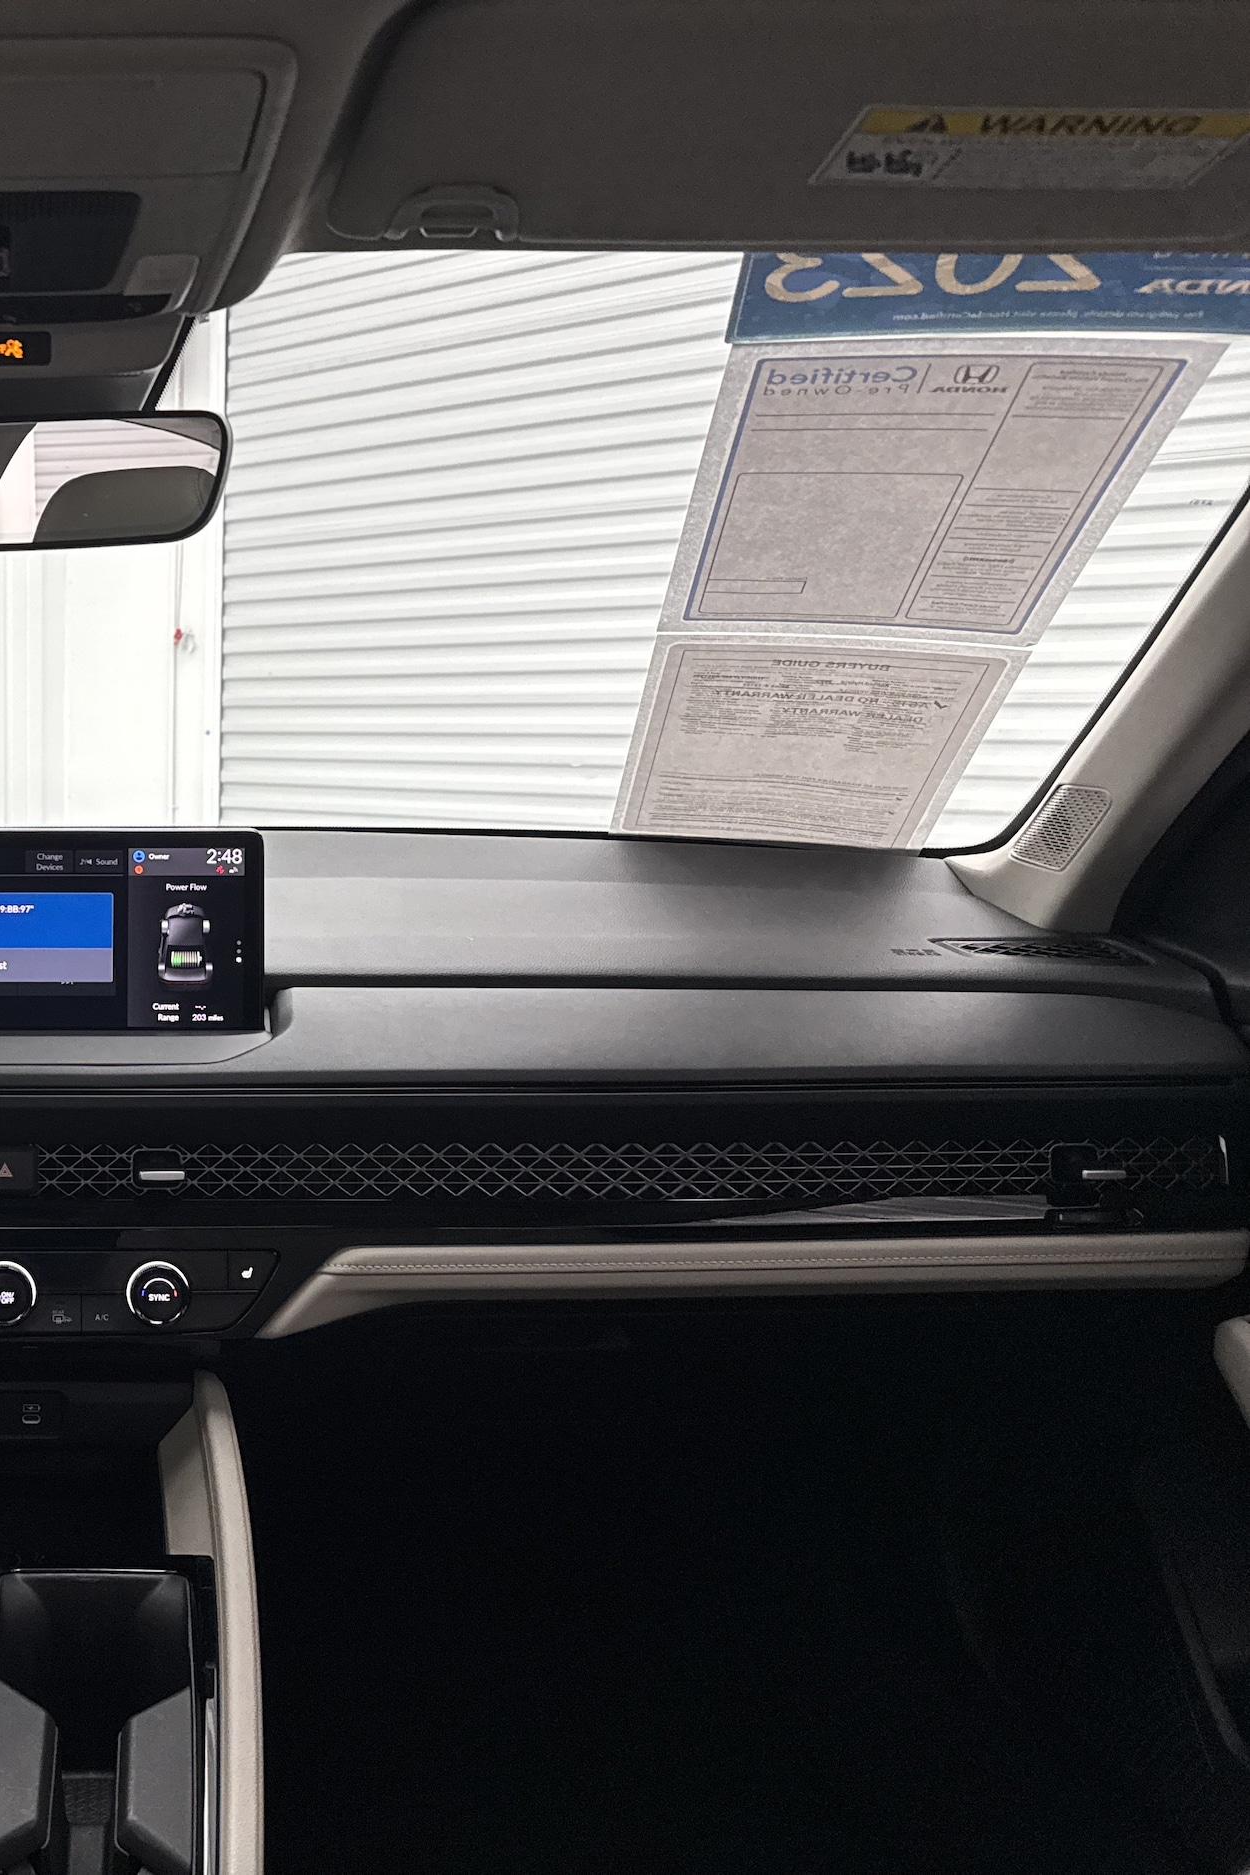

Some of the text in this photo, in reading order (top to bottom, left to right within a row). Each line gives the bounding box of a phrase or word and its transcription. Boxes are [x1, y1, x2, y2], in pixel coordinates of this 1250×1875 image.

[979, 113, 1203, 135] WARNING
[36, 853, 64, 862] Change
[206, 848, 243, 865] 2:48
[95, 858, 118, 866] Sound
[36, 863, 64, 871] Devices
[165, 883, 207, 892] Power Flow
[157, 1013, 179, 1022] Range
[148, 1293, 170, 1301] SYNC
